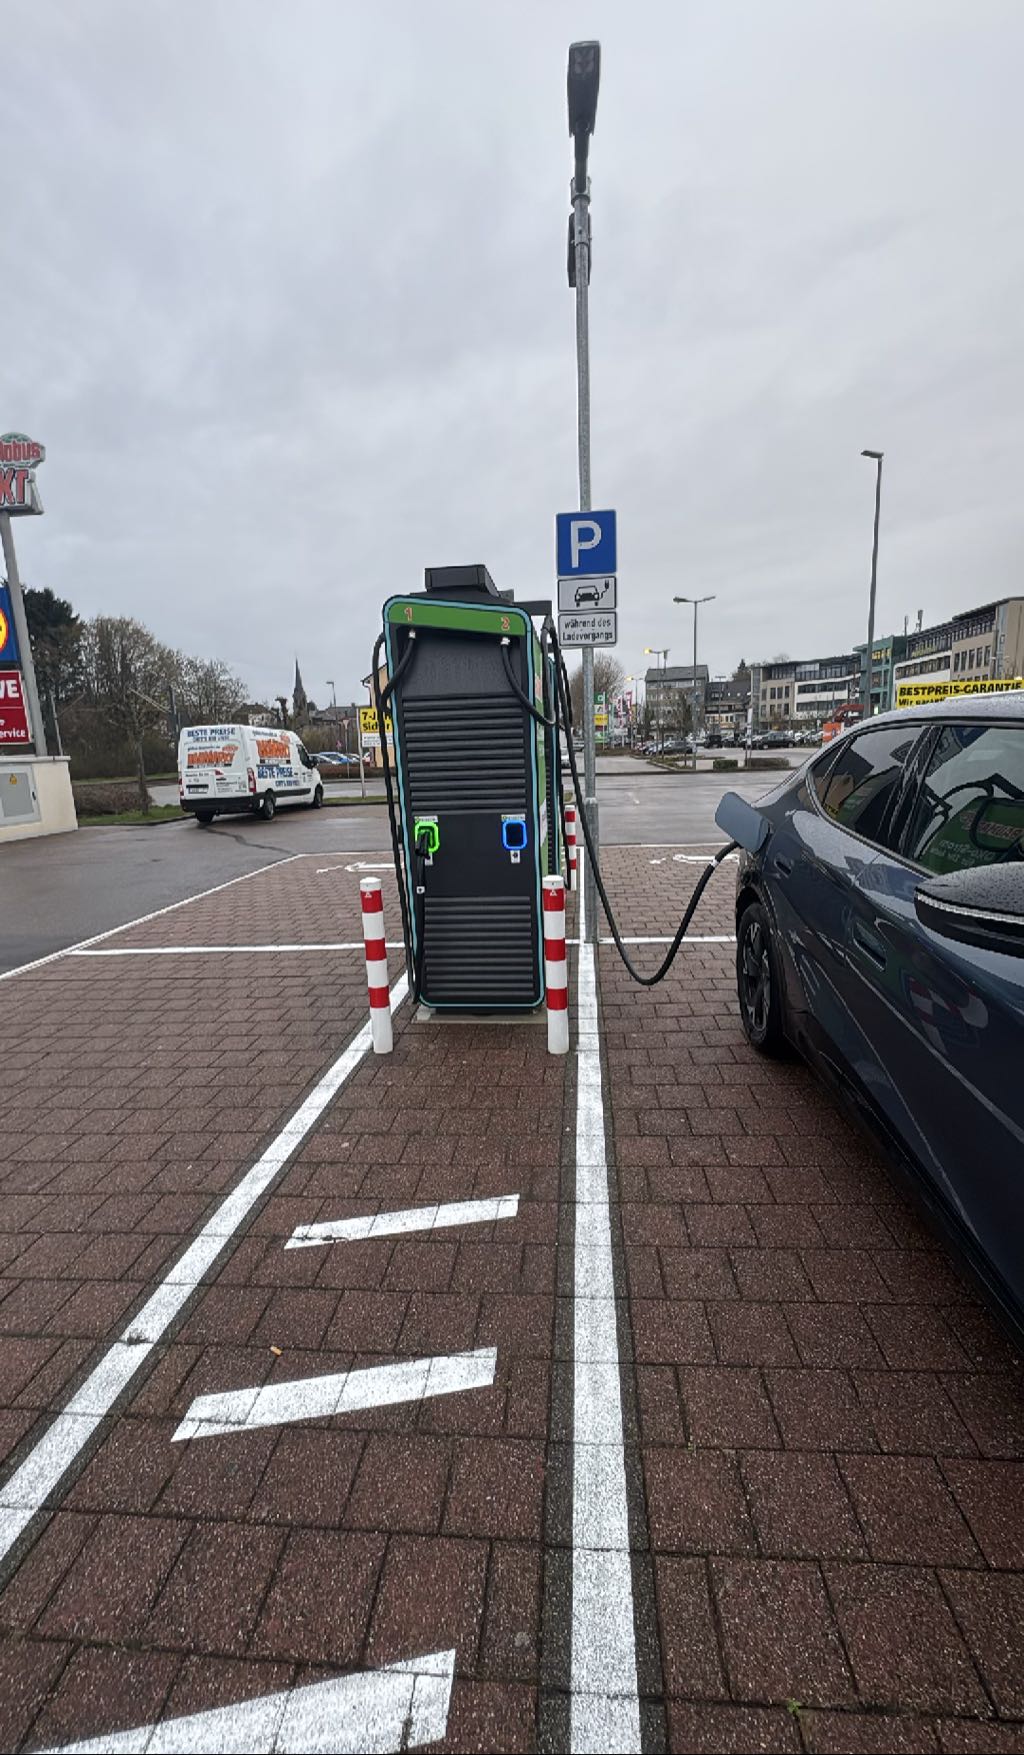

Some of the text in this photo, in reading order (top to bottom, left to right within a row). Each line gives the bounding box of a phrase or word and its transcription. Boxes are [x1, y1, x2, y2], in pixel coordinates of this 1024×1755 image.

[570, 520, 602, 569] P
[404, 607, 413, 622] 1
[565, 616, 612, 630] während des
[562, 631, 613, 642] Ladevorgangs
[899, 682, 1023, 696] BESTPREIS-GARANTIE
[899, 698, 914, 706] Wir
